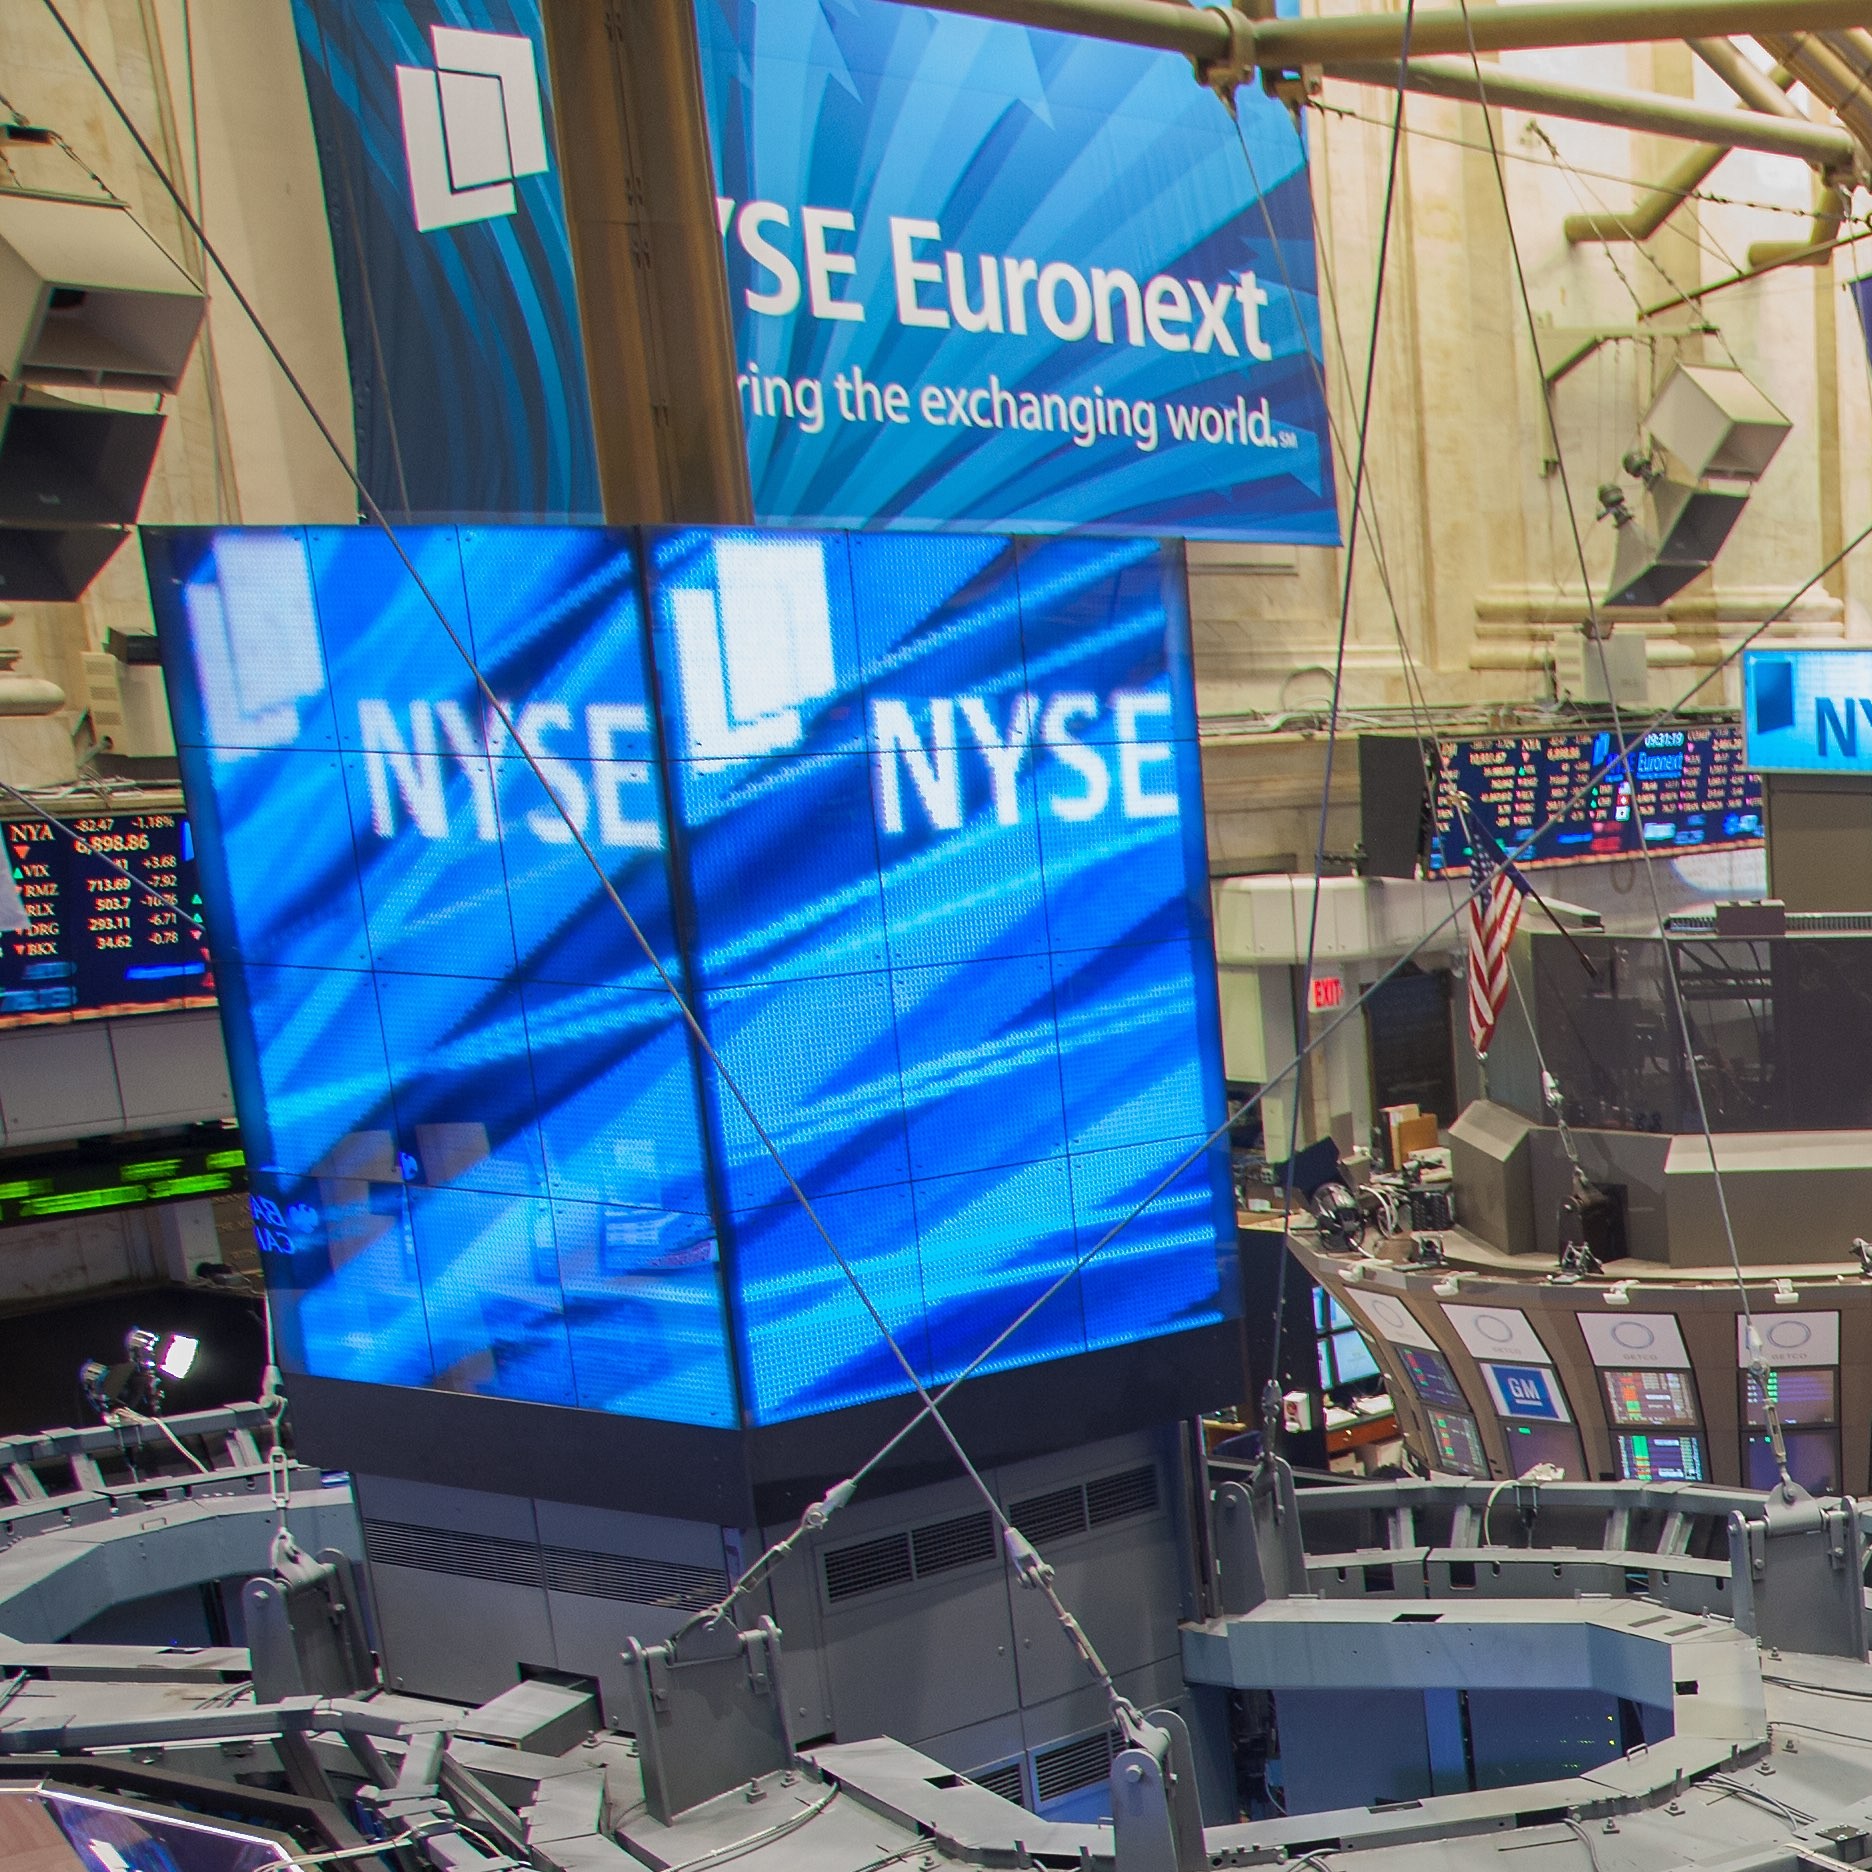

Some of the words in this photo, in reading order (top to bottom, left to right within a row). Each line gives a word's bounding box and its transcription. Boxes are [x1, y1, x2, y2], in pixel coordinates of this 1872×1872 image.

[891, 215, 1273, 361] Euronext
[739, 374, 824, 436] ring
[836, 371, 911, 425] the
[923, 383, 1155, 452] exchanging
[1165, 394, 1279, 449] world.
[1644, 732, 1684, 747] 09:31:19
[870, 691, 1182, 837] NYSE
[1637, 752, 1684, 771] Euronext
[358, 699, 666, 851] NYSE
[10, 824, 55, 842] NYA
[21, 864, 50, 877] VIX
[24, 884, 59, 897] RMZ
[25, 903, 55, 916] RLX
[28, 922, 60, 937] DRG
[88, 916, 130, 931] 293.11
[1314, 977, 1342, 1007] EXIT
[1509, 1379, 1539, 1400] GM
